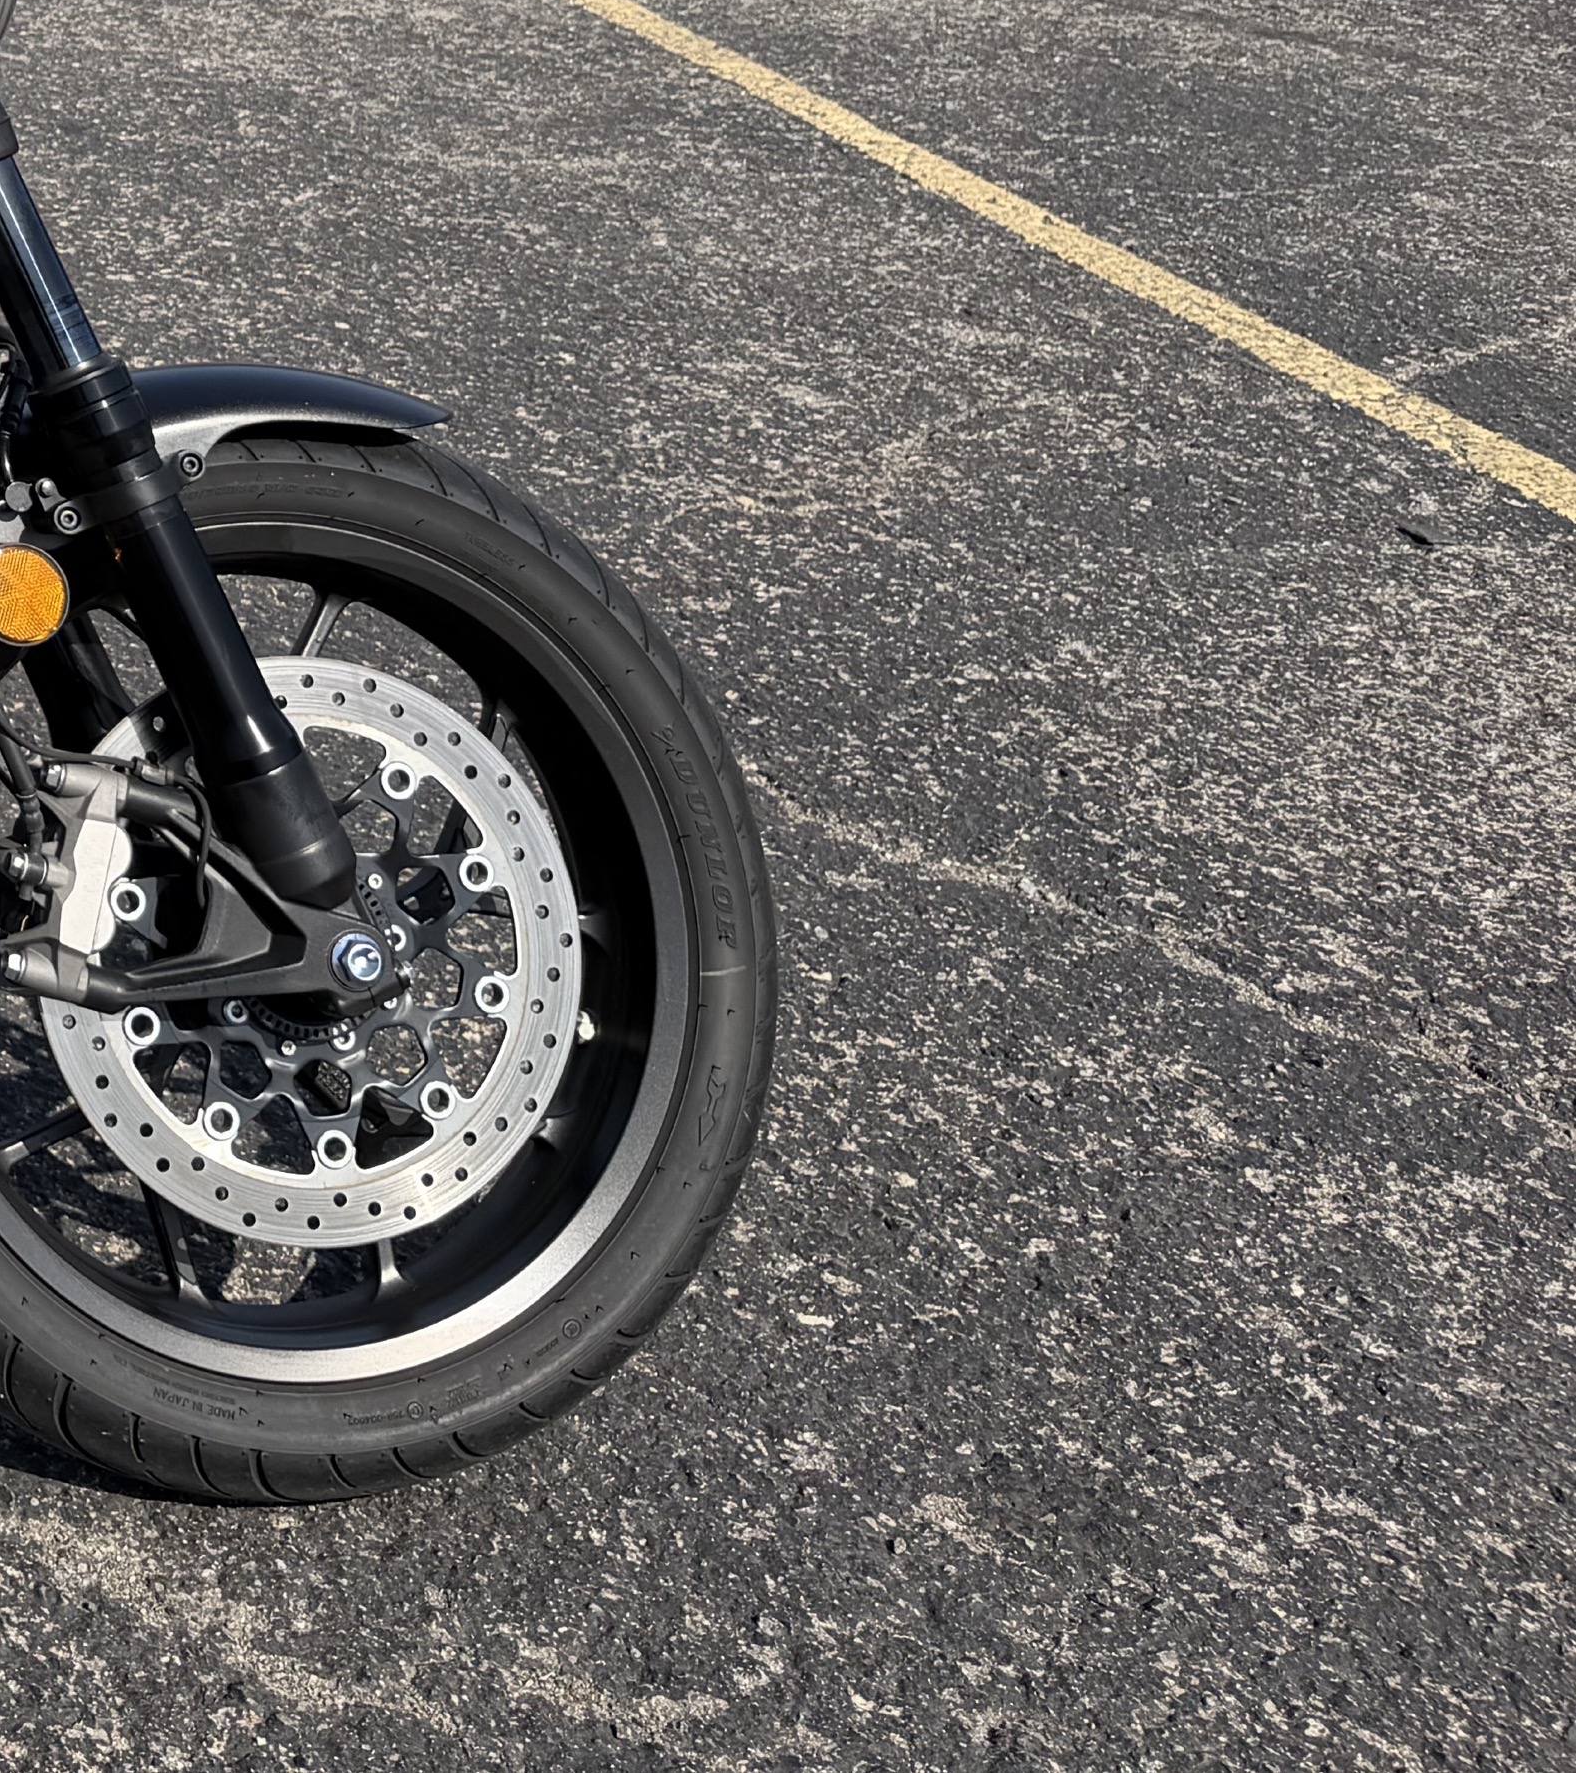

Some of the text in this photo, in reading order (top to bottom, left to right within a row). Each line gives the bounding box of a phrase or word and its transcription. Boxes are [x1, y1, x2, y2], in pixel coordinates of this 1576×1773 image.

[668, 757, 740, 949] DUNLOP
[152, 1386, 190, 1408] JAPAN
[192, 1399, 203, 1413] IN
[207, 1404, 235, 1422] MADE
